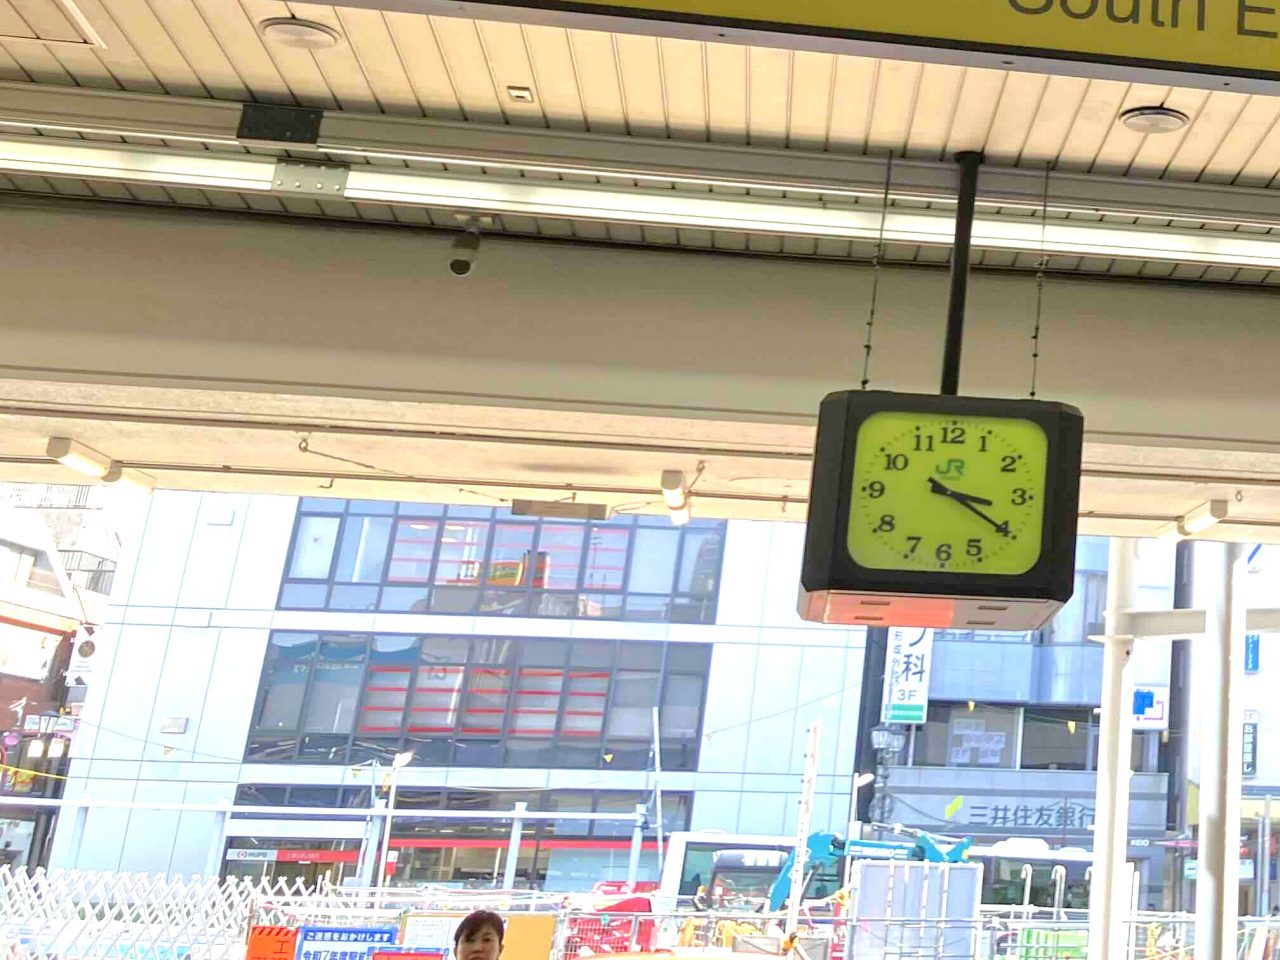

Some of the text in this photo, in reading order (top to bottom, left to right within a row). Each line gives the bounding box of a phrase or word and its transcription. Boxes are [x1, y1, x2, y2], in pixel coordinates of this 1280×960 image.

[913, 434, 935, 452] 11
[940, 427, 966, 444] 12
[978, 436, 988, 452] 1
[883, 454, 909, 471] 10
[935, 458, 965, 477] JR
[1000, 456, 1017, 473] 2
[869, 481, 885, 498] 9
[1011, 488, 1028, 506] 3
[878, 515, 896, 533] 8
[995, 520, 1012, 538] 4
[905, 536, 922, 554] 7
[935, 544, 953, 561] 6
[965, 539, 983, 557] 5
[896, 688, 918, 701] 3F
[969, 804, 1096, 828] 三井住友銀行
